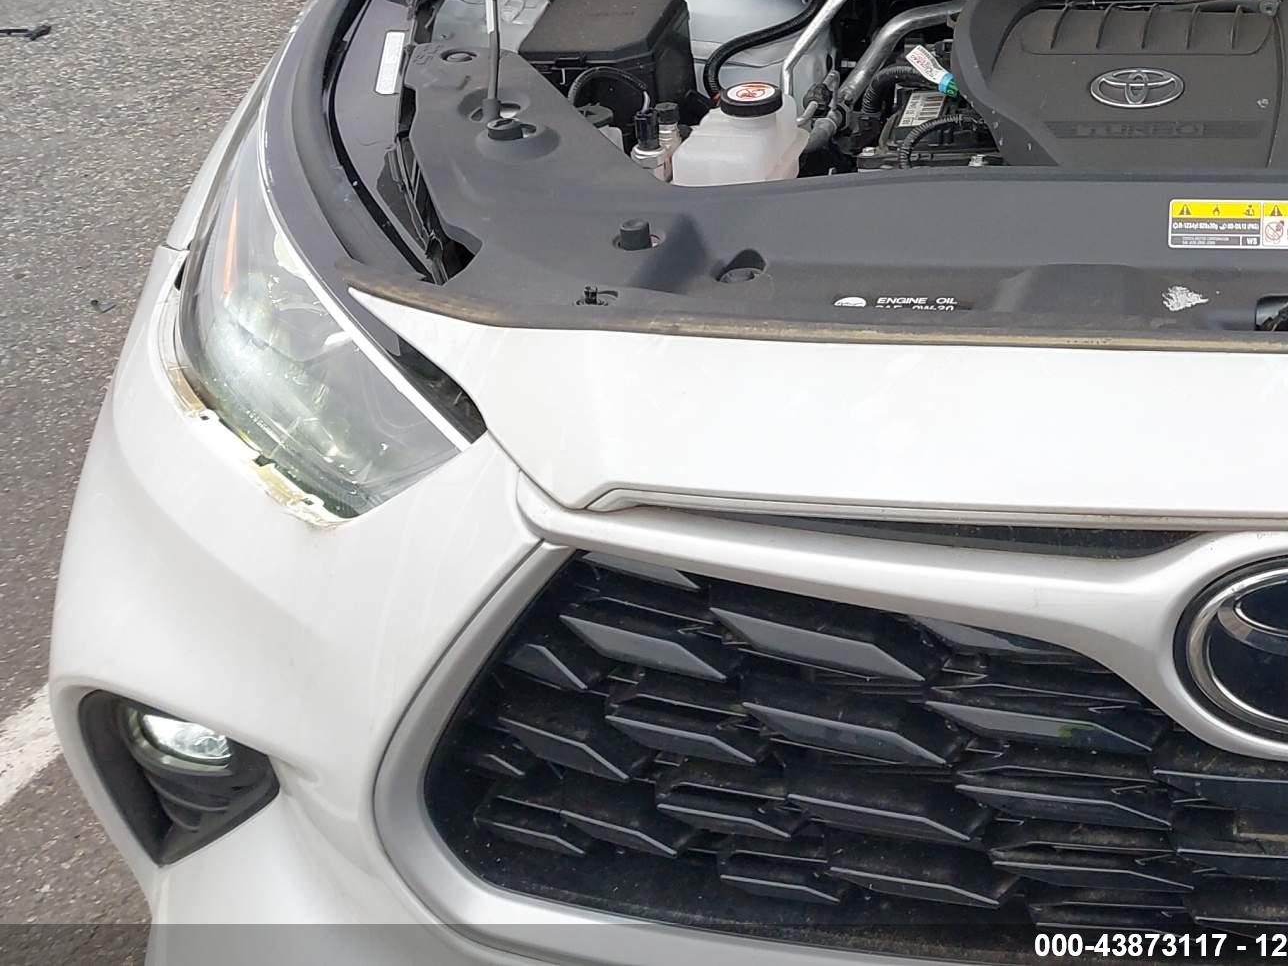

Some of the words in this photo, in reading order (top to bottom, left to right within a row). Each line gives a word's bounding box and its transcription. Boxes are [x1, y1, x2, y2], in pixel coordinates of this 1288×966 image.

[1077, 122, 1204, 136] TURBO
[877, 297, 928, 305] ENGINE
[935, 297, 958, 305] OIL
